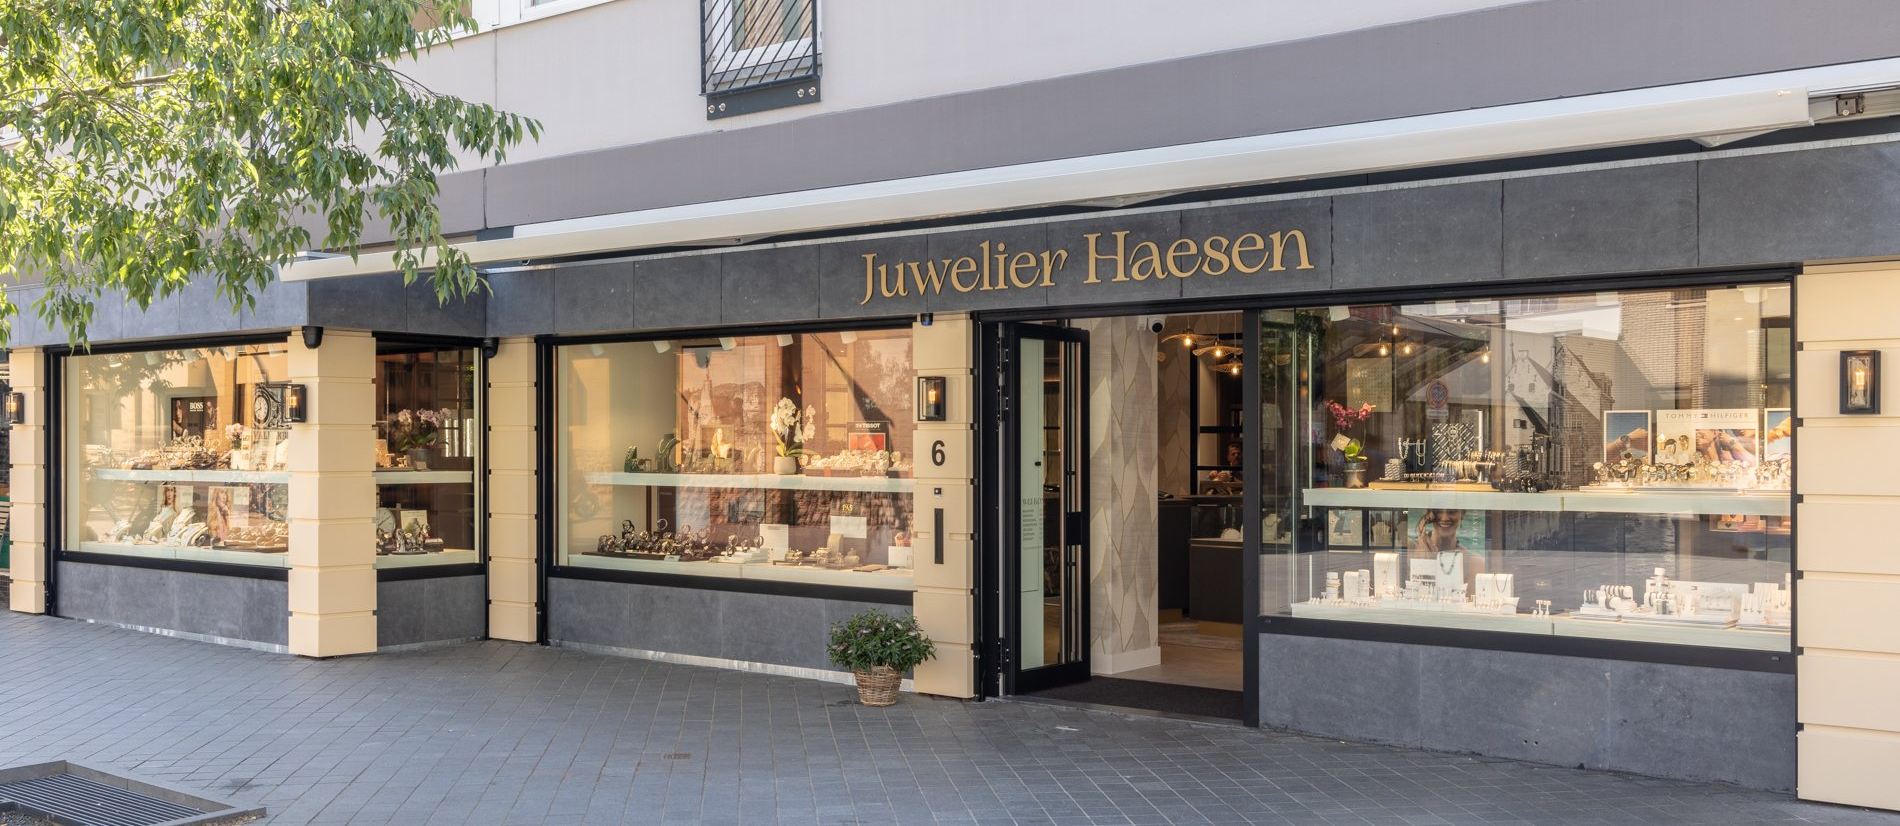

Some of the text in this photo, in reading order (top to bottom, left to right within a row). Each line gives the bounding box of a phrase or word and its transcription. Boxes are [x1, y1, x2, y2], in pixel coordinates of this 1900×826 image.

[860, 229, 1315, 306] Juwelier Haesen
[189, 401, 203, 409] BOSS
[931, 439, 946, 467] 6
